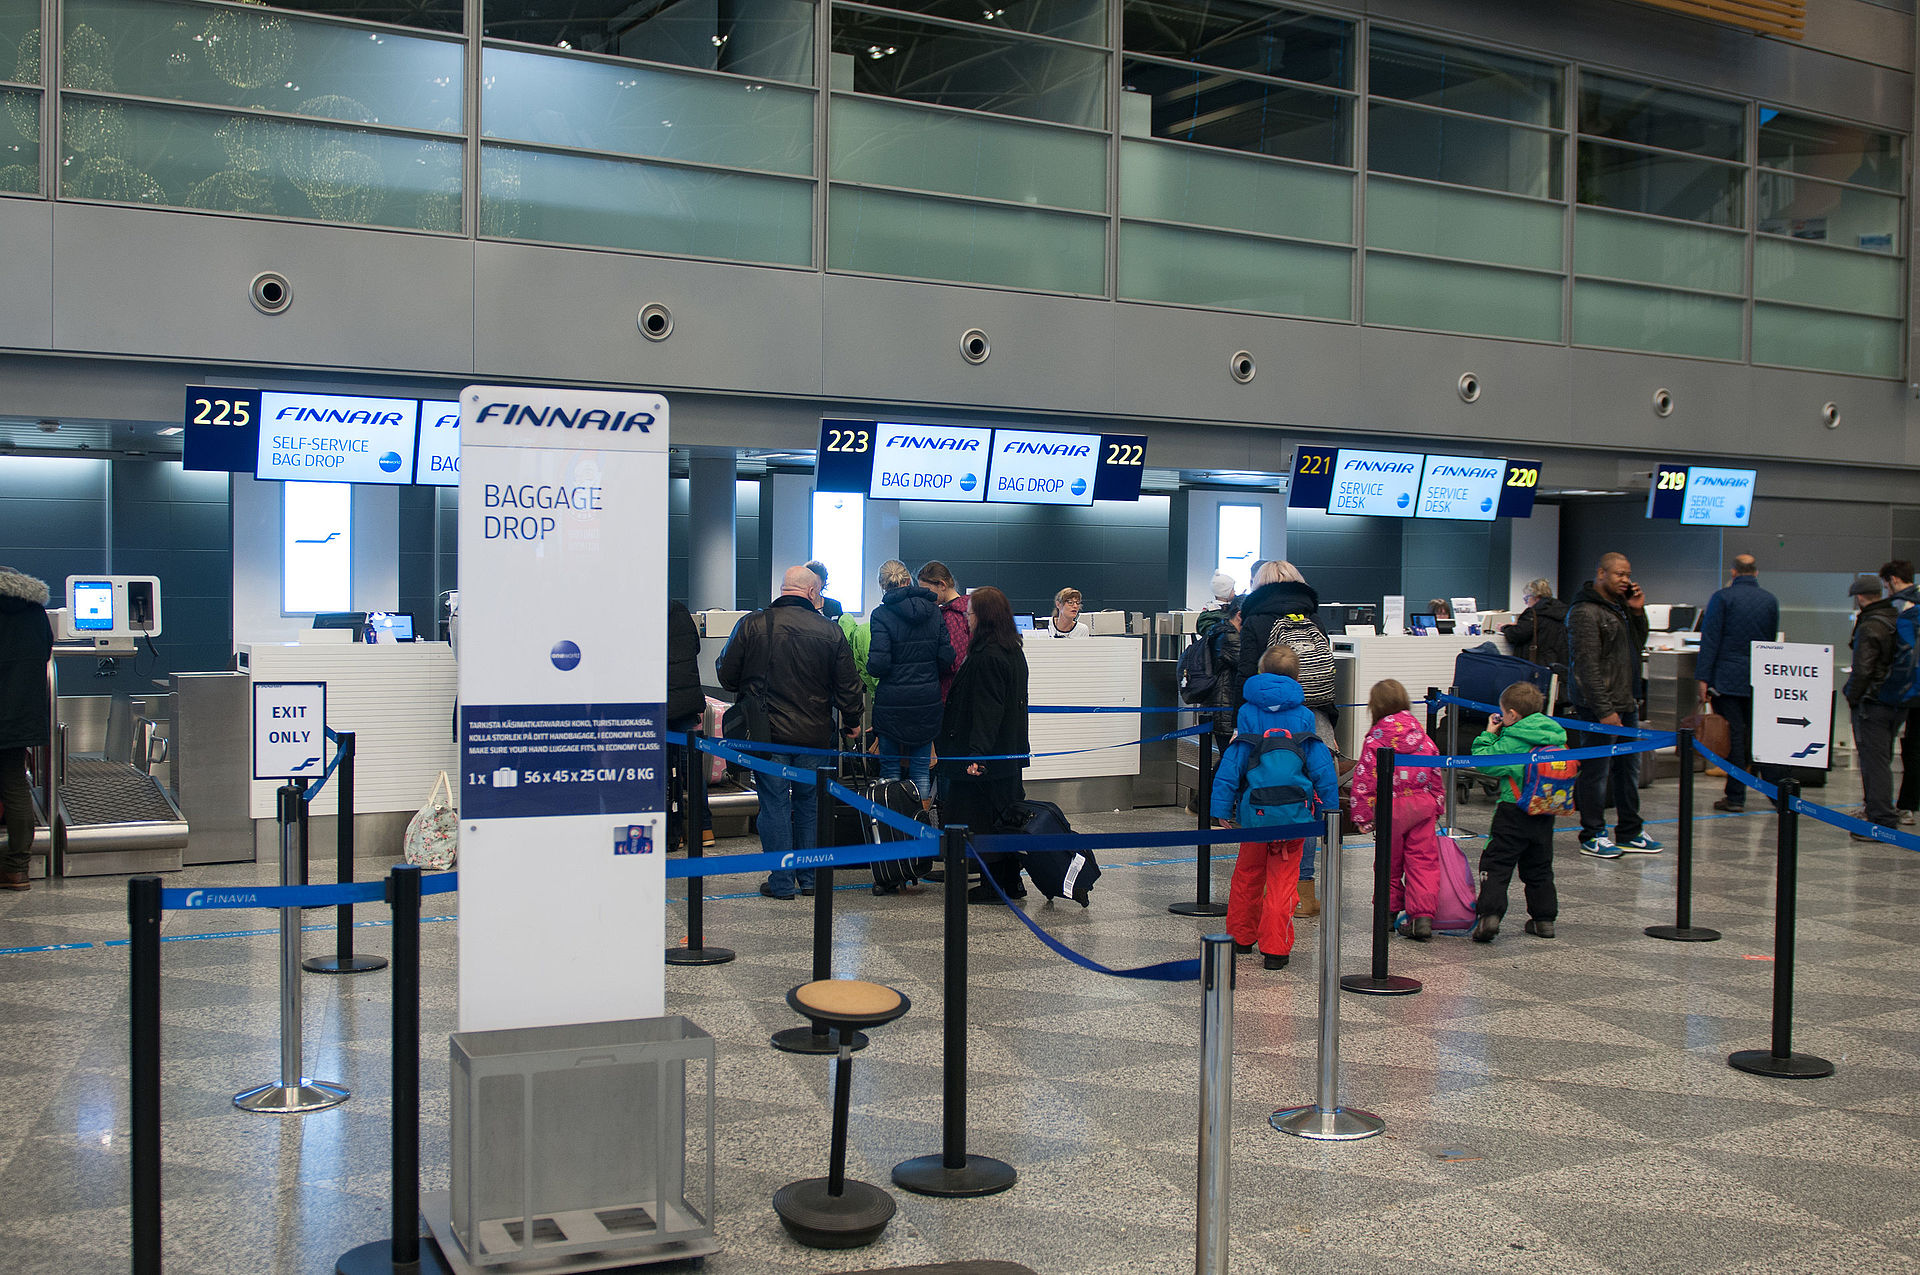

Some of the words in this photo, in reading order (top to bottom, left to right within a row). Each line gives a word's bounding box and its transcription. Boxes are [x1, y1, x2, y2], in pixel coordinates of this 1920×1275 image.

[193, 399, 250, 426] 225
[276, 406, 403, 426] FINNAIR
[476, 403, 656, 432] FINNAIR
[272, 436, 368, 453] SELF-SERVICE
[827, 430, 868, 452] 223
[886, 435, 980, 451] FINNAIR
[1003, 441, 1090, 457] FINNAIR
[1106, 444, 1143, 465] 222
[272, 453, 301, 466] BAG
[305, 455, 345, 468] DROP
[1300, 455, 1330, 475] 221
[1344, 460, 1414, 474] FINNAIR
[1432, 465, 1498, 478] FINNAIR
[1507, 468, 1537, 487] 220
[882, 472, 910, 488] BAG
[914, 473, 952, 488] DROP
[998, 476, 1025, 491] BAG
[1028, 478, 1064, 492] DROP
[1658, 471, 1685, 490] 219
[1694, 476, 1749, 487] FINNAIR
[1340, 481, 1383, 496] SERVICE
[1428, 486, 1469, 500] SERVICE
[484, 484, 603, 510] BAGGAGE
[1338, 496, 1365, 509] DESK
[1691, 495, 1725, 508] SERVICE
[1425, 500, 1450, 512] DESK
[484, 516, 556, 540] DROP
[1764, 664, 1818, 678] SERVICE
[1774, 688, 1808, 701] DESK
[272, 706, 307, 718] EXIT
[269, 731, 310, 743] ONLY
[490, 746, 508, 754] SURE
[468, 773, 475, 785] 1
[478, 774, 486, 784] x
[524, 771, 540, 783] 56
[543, 772, 551, 782] x
[552, 770, 569, 782] 45
[571, 772, 578, 782] x
[580, 770, 595, 782] 25
[597, 769, 616, 781] CM
[618, 768, 625, 782] /
[626, 769, 635, 780] 8
[638, 768, 654, 780] KG
[796, 853, 834, 864] FINAVIA
[206, 893, 257, 904] FINAVIA
